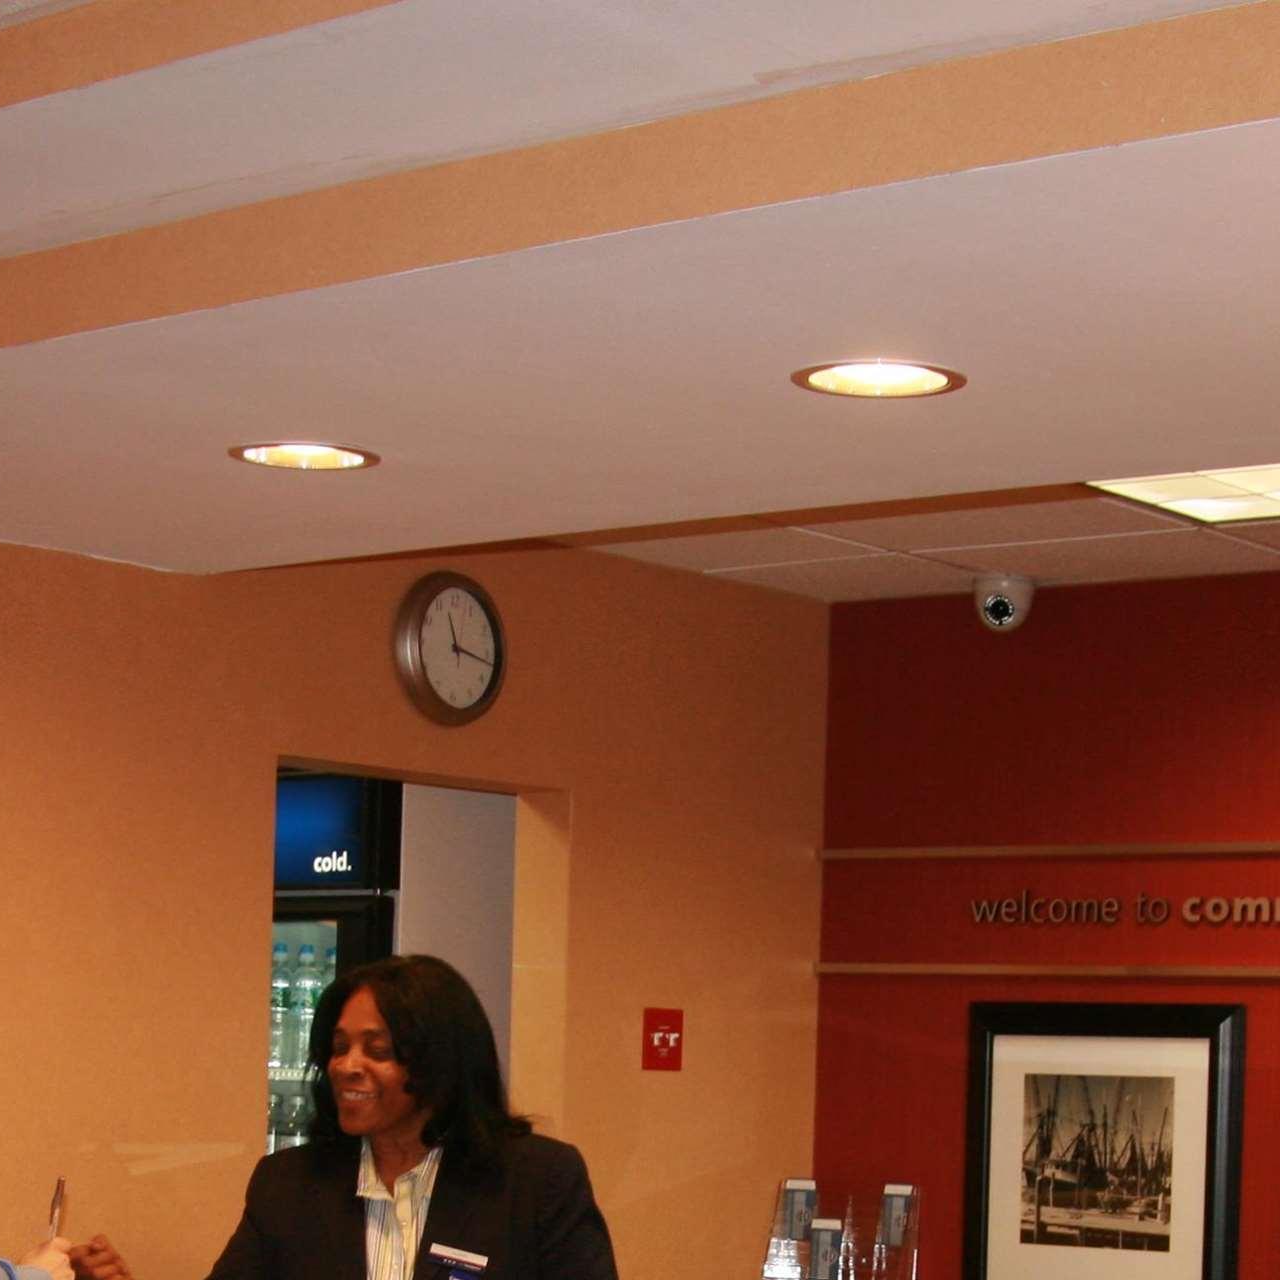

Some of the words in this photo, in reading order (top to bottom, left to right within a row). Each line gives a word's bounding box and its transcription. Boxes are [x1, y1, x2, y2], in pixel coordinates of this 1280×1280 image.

[313, 850, 353, 873] cold.
[971, 889, 1119, 923] welcome
[1136, 891, 1169, 923] to
